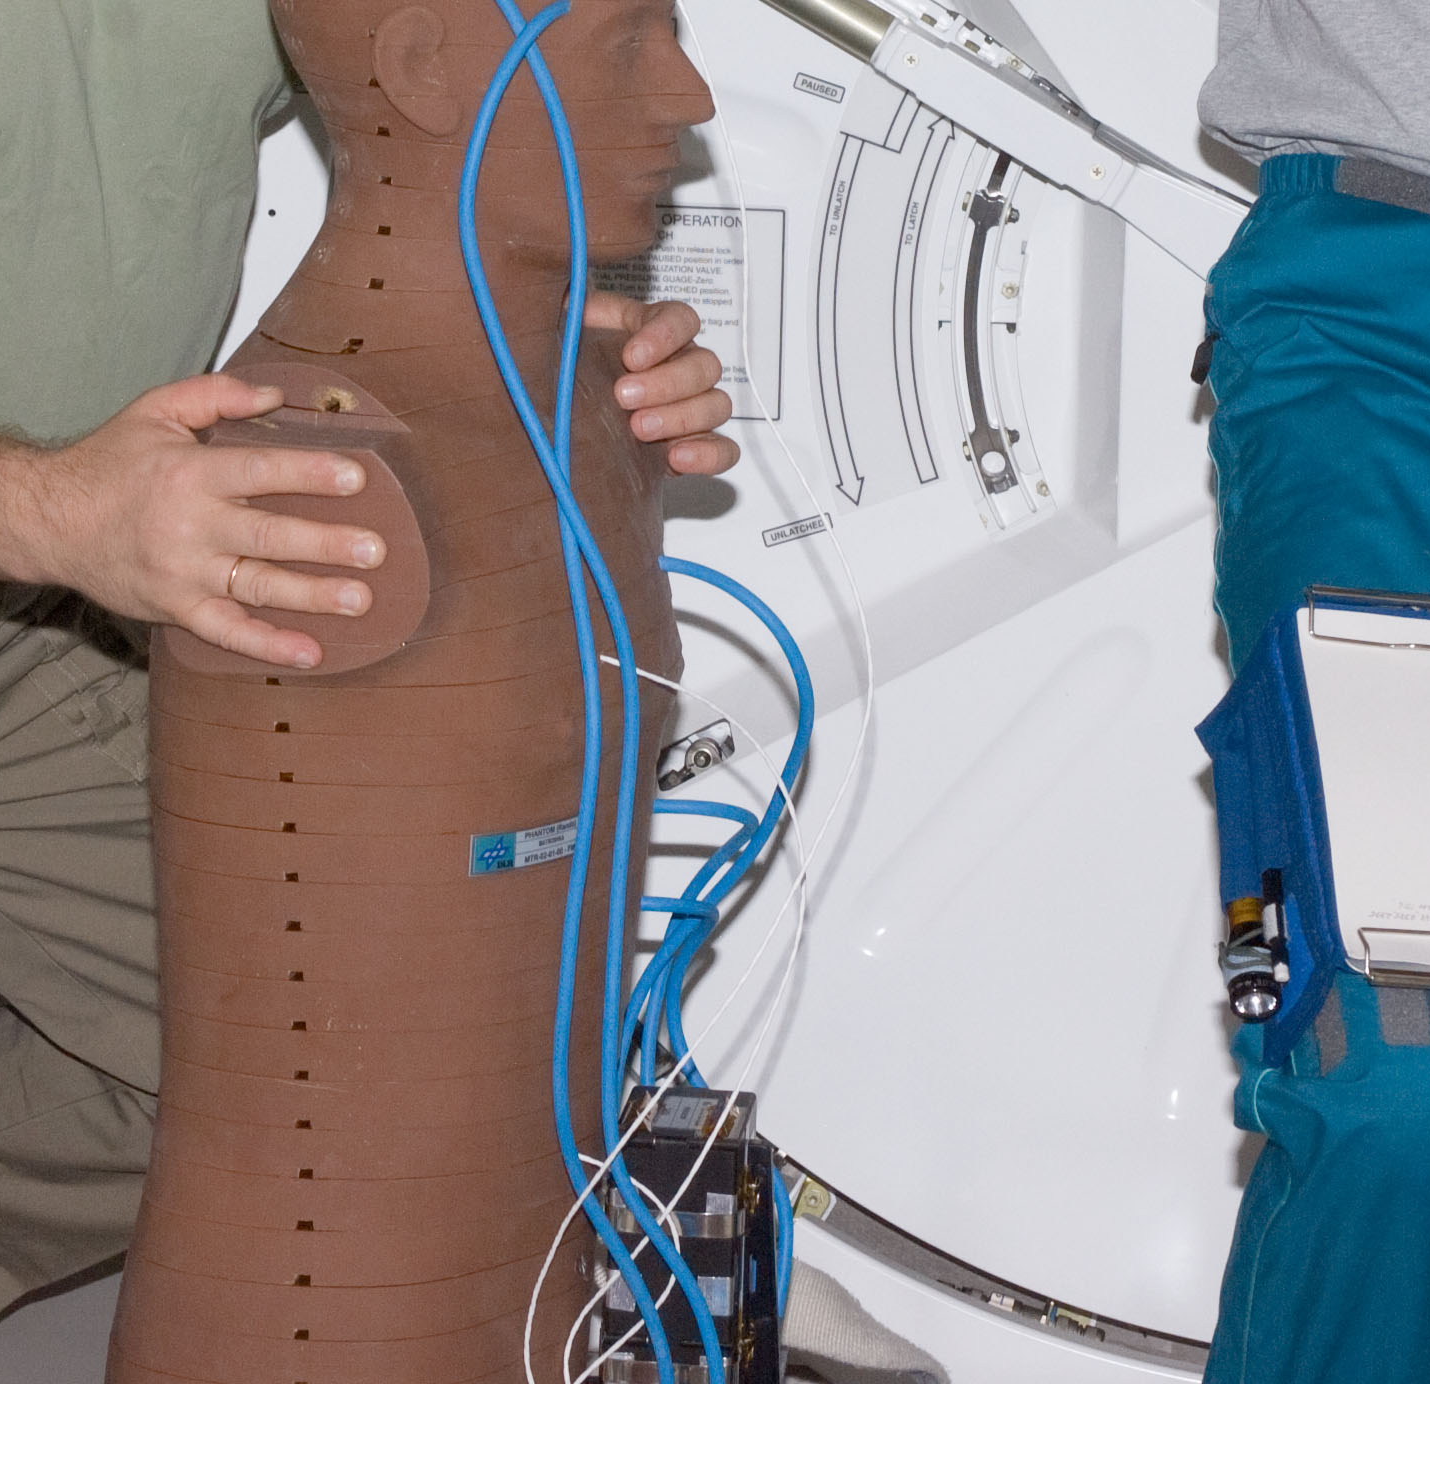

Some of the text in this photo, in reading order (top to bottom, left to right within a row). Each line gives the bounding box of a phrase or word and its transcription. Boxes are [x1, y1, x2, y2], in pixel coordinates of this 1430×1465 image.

[800, 78, 839, 99] PAUSED
[830, 180, 847, 237] TO UNLATCH
[661, 214, 743, 228] OPERATION
[904, 201, 919, 246] TO LATCH
[686, 245, 714, 254] release
[651, 255, 745, 266] PAUSED position in order
[645, 286, 698, 295] UNLATCHED
[702, 297, 733, 306] stopped
[708, 318, 722, 327] bag
[770, 519, 826, 542] UNLATCHED
[524, 826, 556, 839] PHANTOM
